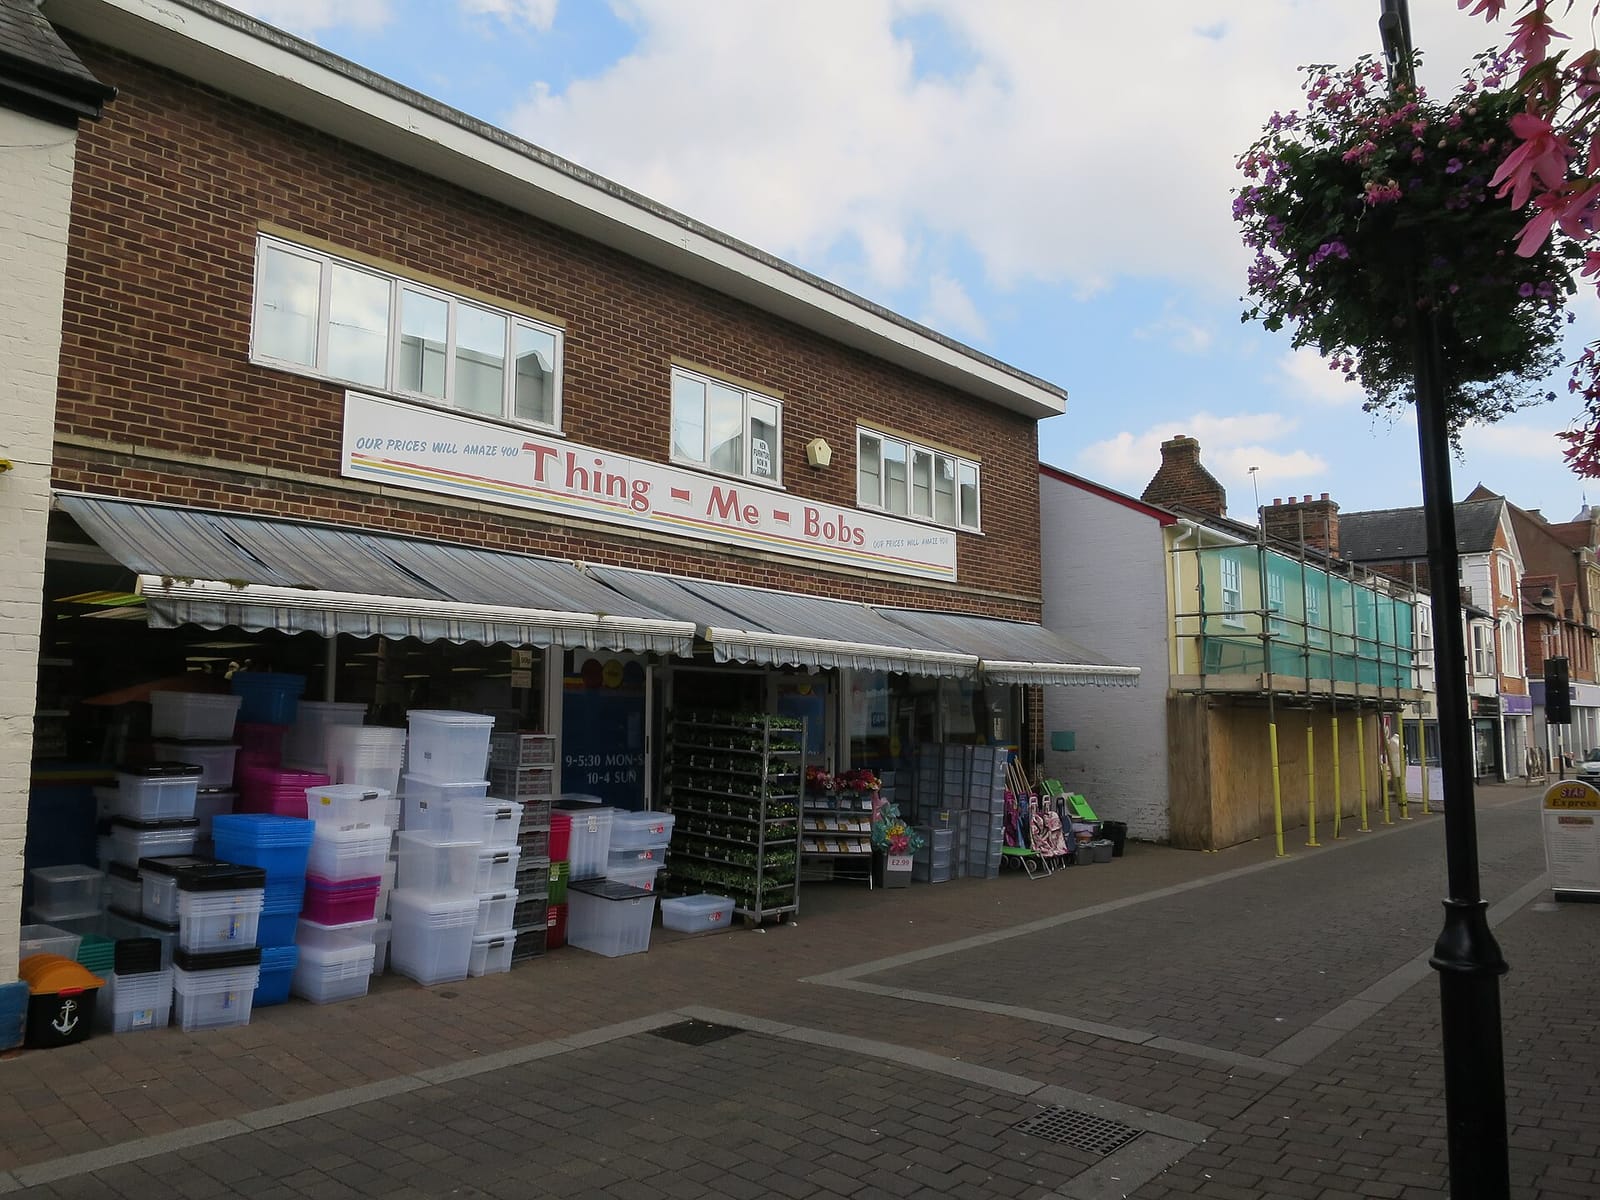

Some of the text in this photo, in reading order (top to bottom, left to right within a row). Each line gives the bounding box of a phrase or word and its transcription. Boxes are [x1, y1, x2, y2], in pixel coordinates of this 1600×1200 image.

[356, 437, 519, 457] OUR PRICES WILL AMAZE YOU
[521, 441, 866, 546] Thing - Me - Bobs
[565, 754, 601, 768] 9-5:30
[587, 770, 637, 785] 10-4 SUN
[1560, 787, 1586, 799] STAR
[1552, 799, 1597, 809] Express
